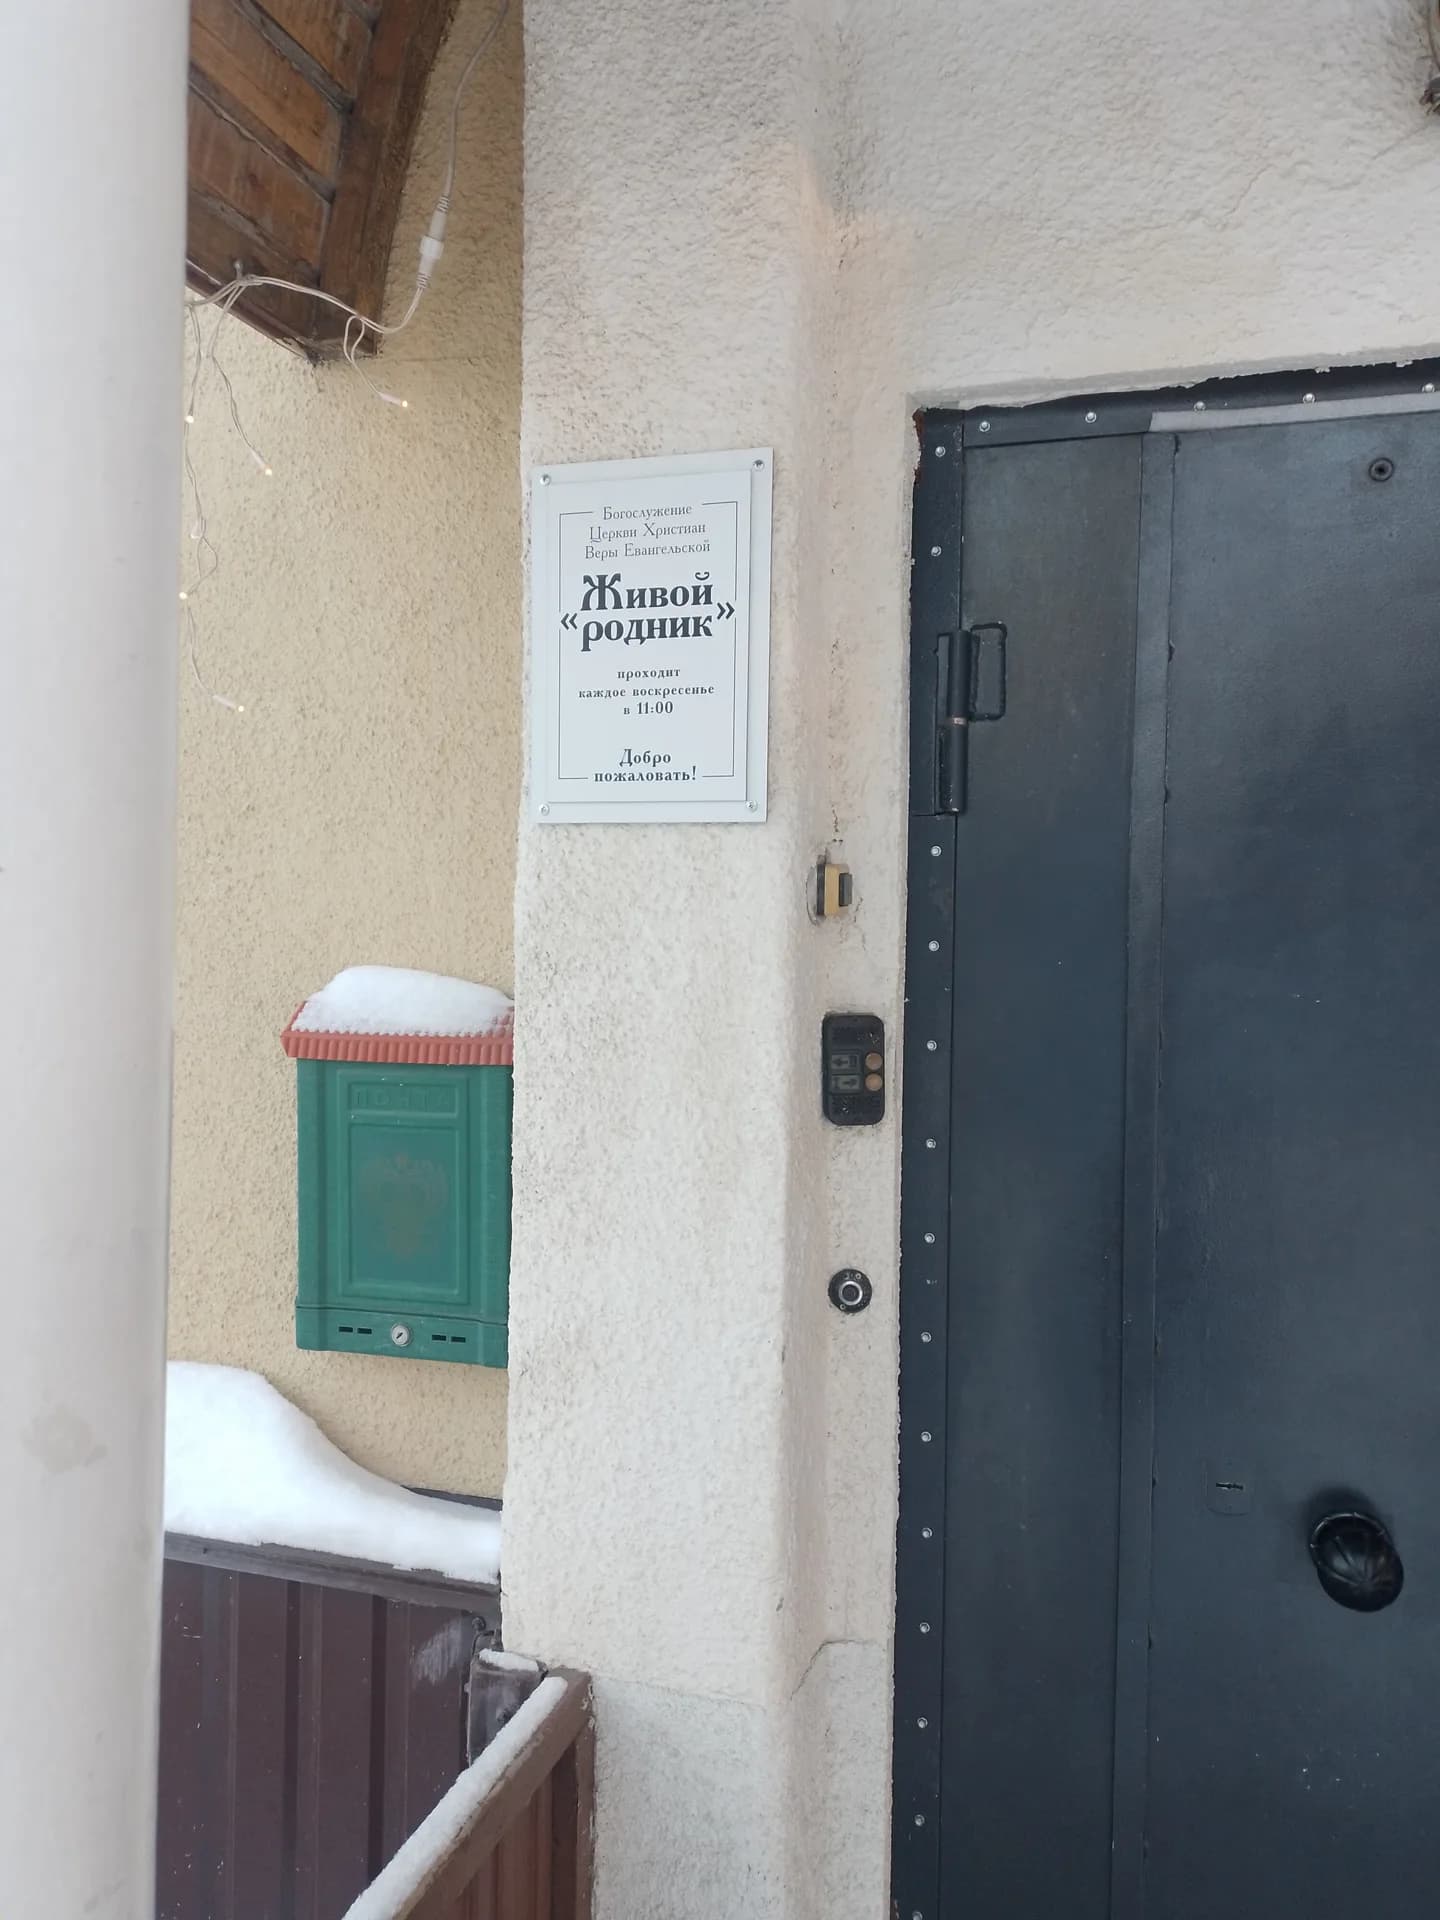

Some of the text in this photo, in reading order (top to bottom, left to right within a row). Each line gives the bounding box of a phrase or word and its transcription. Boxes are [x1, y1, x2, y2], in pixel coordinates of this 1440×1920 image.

[603, 505, 693, 521] Богослужение
[589, 522, 706, 543] Церкви Христиан
[585, 539, 711, 561] Веры Евангельской
[580, 571, 714, 611] Живой
[617, 668, 681, 682] проходит
[578, 685, 715, 699] каждое воскресенье
[623, 701, 674, 715] в 11:00
[619, 749, 672, 767] Добро
[594, 765, 697, 783] пожаловать!
